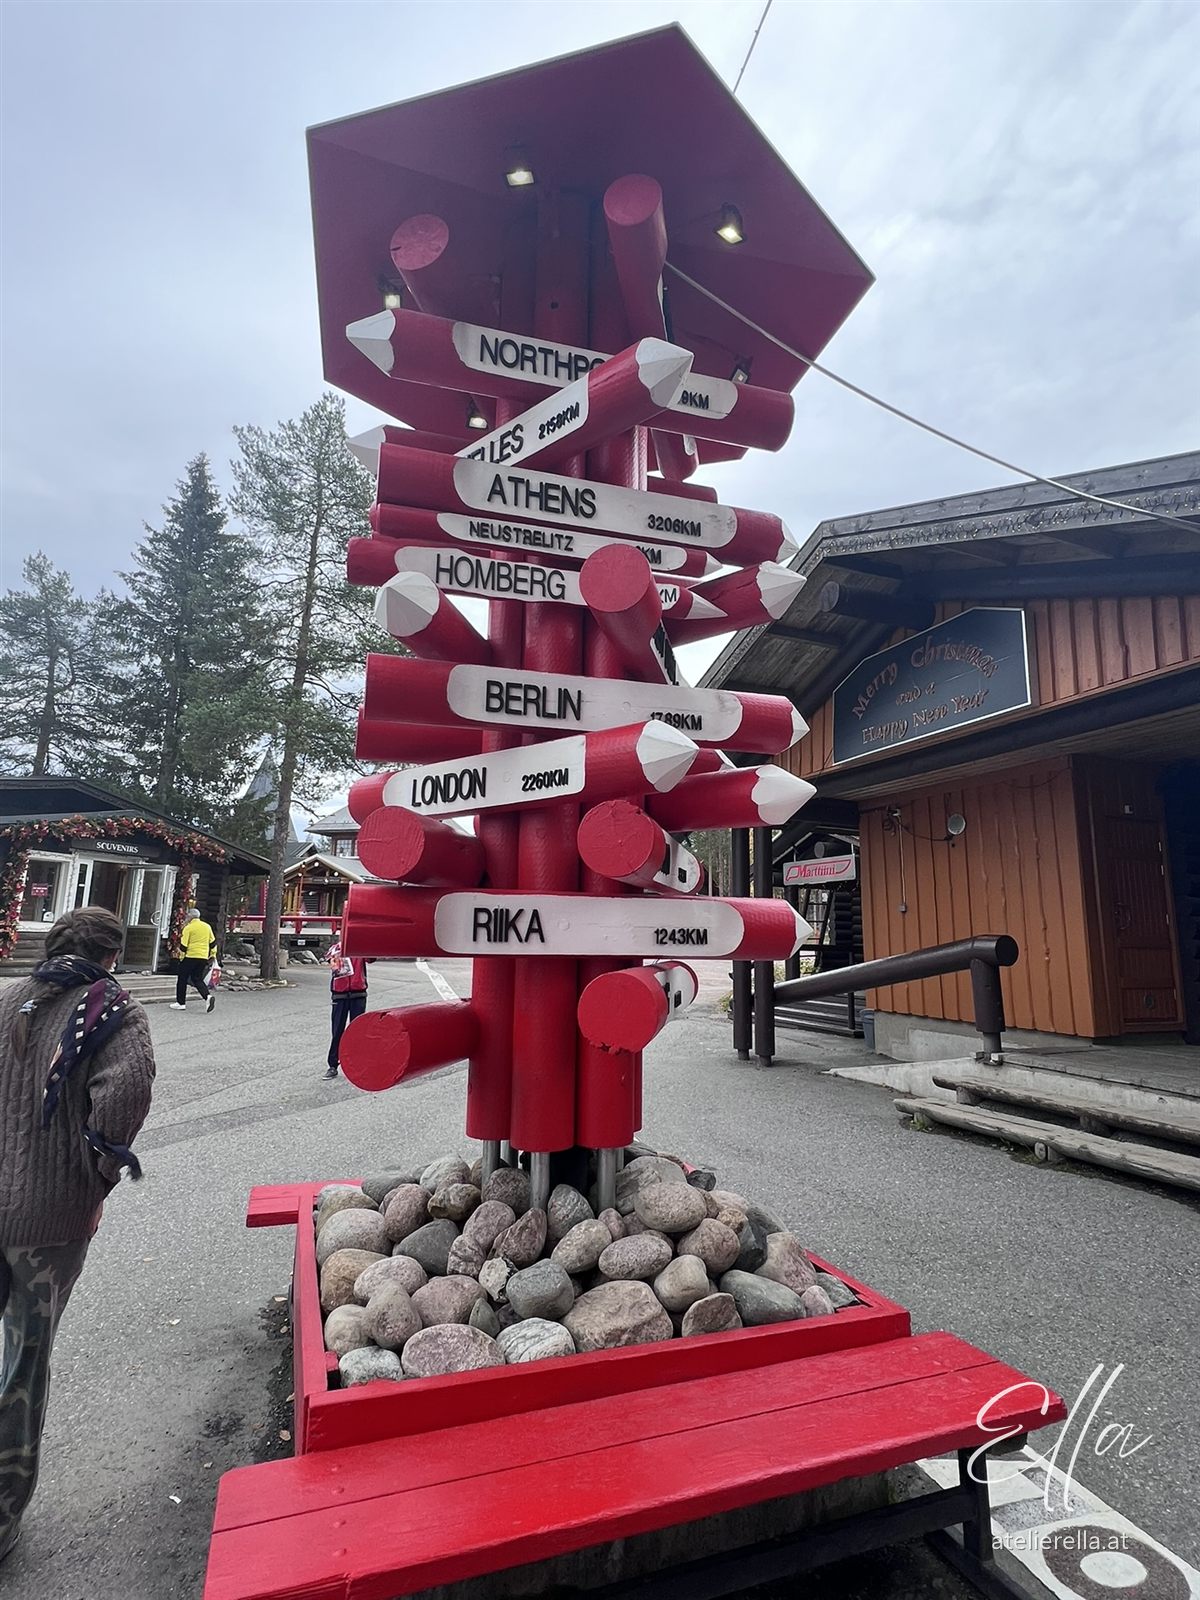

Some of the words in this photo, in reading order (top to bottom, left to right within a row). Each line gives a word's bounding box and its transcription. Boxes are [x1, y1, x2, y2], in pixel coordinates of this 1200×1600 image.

[487, 473, 597, 519] ATHENS
[647, 514, 701, 537] 3206KM
[469, 520, 574, 552] NEUSTRELITZ
[636, 545, 662, 565] KM
[435, 553, 567, 600] HOMBERG
[485, 679, 582, 721] BERLIN
[852, 661, 898, 720] Merry
[910, 635, 999, 678] Christmas
[861, 718, 909, 745] Happy
[912, 703, 948, 728] New
[950, 688, 989, 714] Year
[411, 766, 487, 808] LONDON
[521, 768, 569, 793] 2260KM
[96, 841, 139, 854] SOUVENIRS
[654, 928, 708, 945] 1243KM
